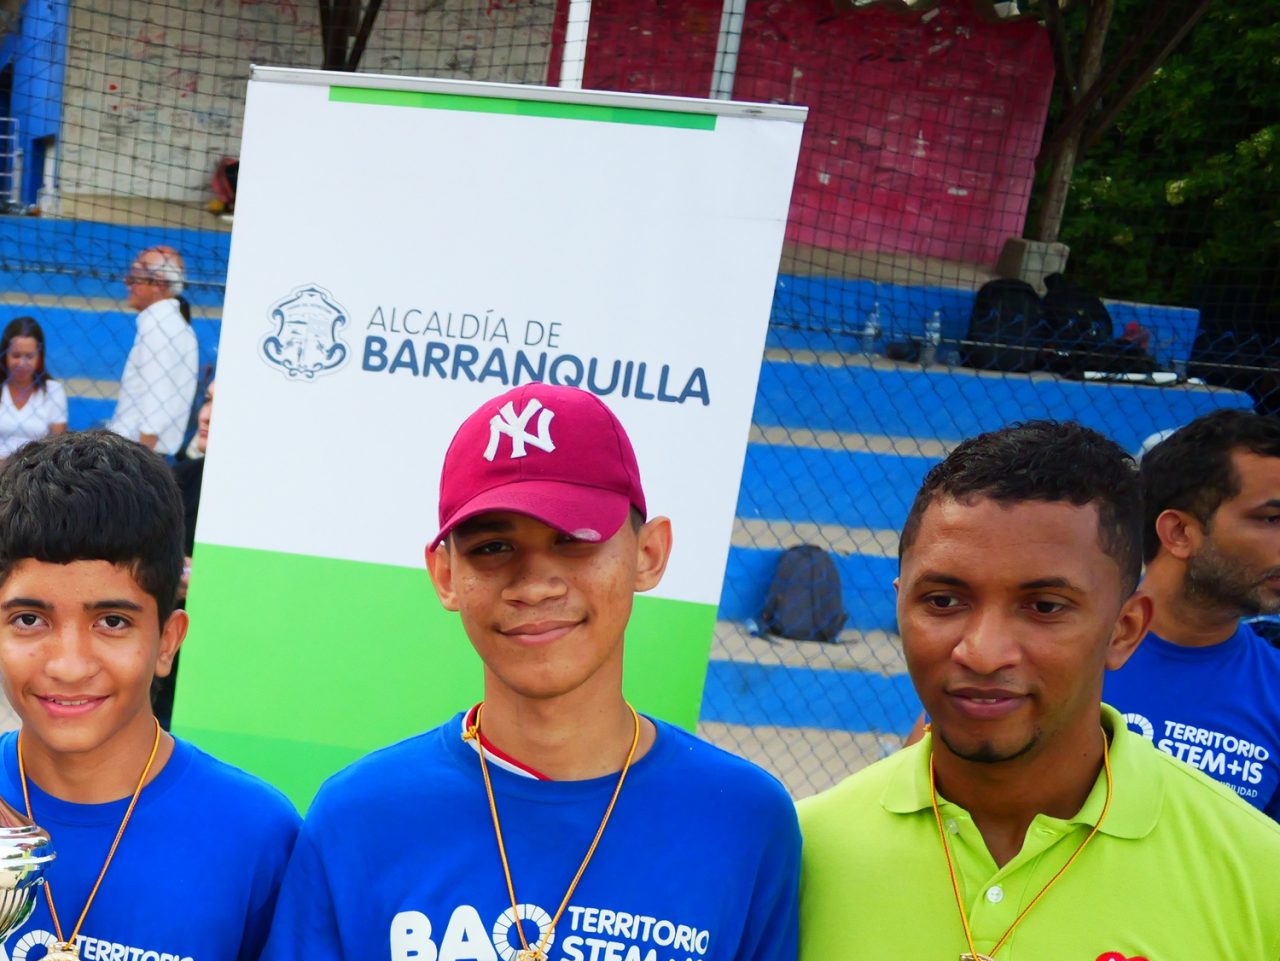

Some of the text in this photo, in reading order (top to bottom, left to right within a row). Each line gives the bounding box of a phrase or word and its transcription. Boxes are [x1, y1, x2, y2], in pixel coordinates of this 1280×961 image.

[366, 305, 562, 348] ALCALDÍA DE
[362, 335, 711, 406] BARRANQUILLA
[1164, 720, 1269, 761] TERRITORIO
[568, 905, 710, 956] TERRITORIO
